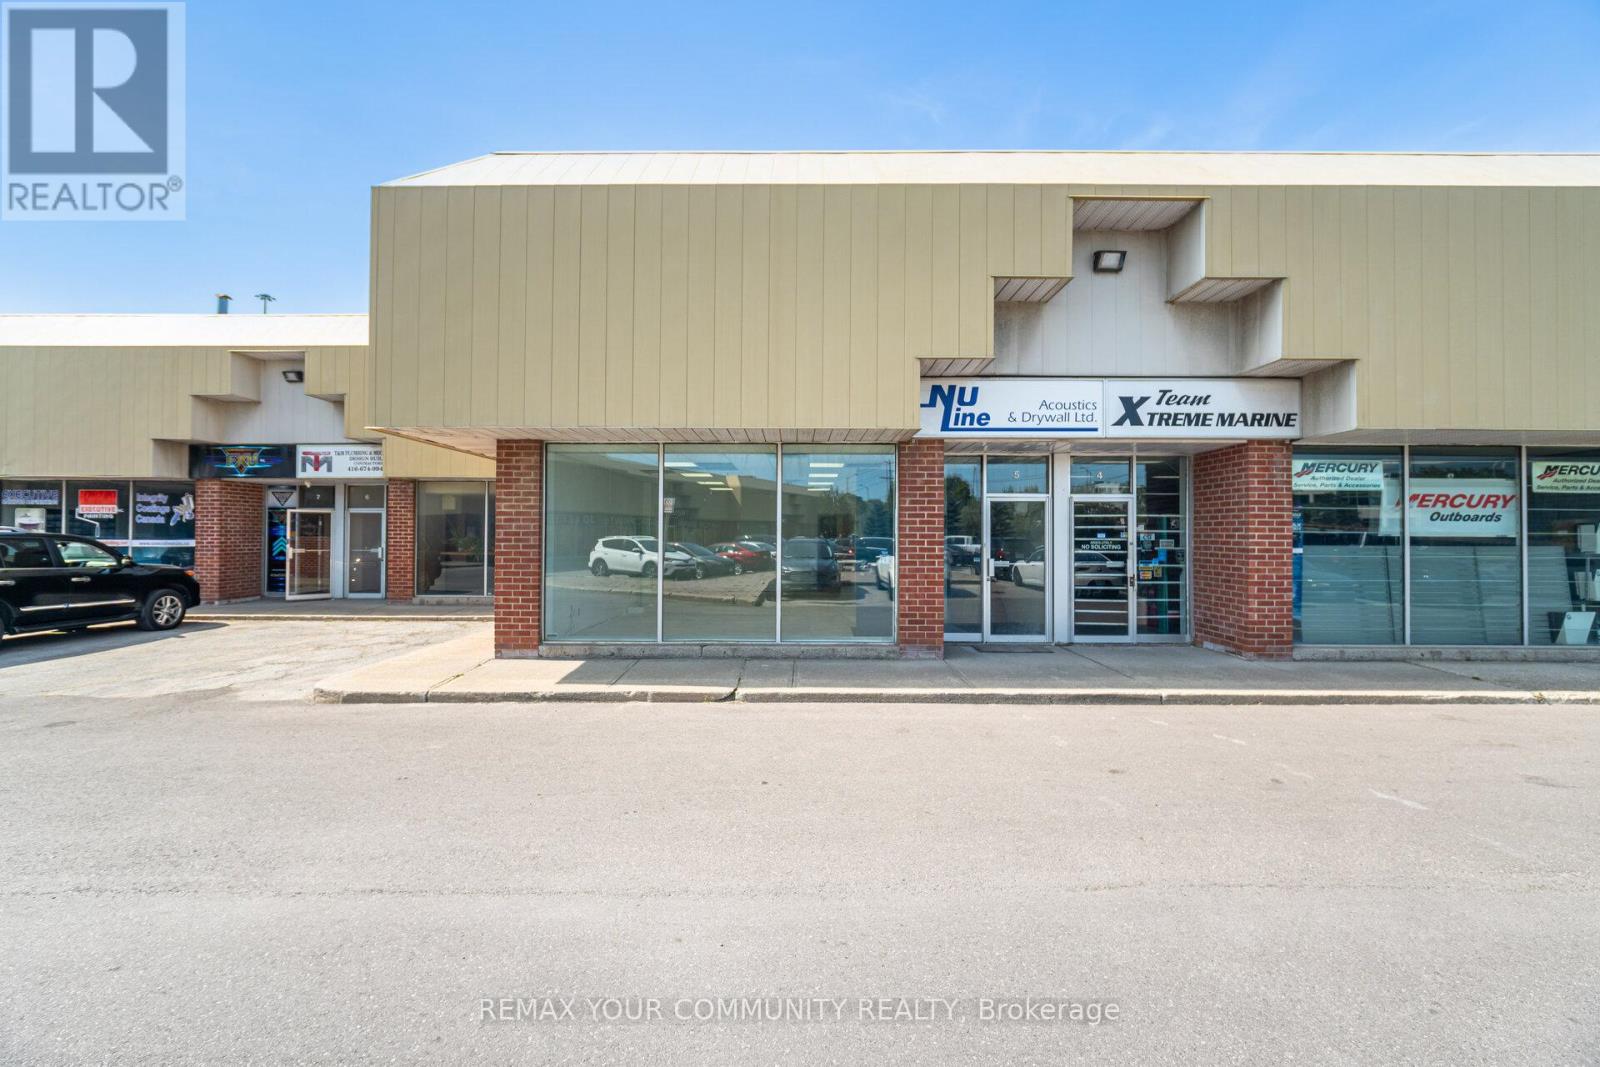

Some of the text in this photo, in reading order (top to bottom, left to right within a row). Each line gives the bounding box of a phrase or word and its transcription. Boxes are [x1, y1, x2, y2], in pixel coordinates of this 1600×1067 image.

[1155, 389, 1212, 406] Team
[1039, 399, 1097, 411] Acoustics
[1007, 412, 1098, 425] & Drywall Ltd.
[1216, 412, 1298, 428] MARINE
[1301, 462, 1378, 473] MERCURY
[1013, 471, 1020, 479] 5
[1096, 471, 1103, 480] 4
[1430, 511, 1503, 523] Outboards
